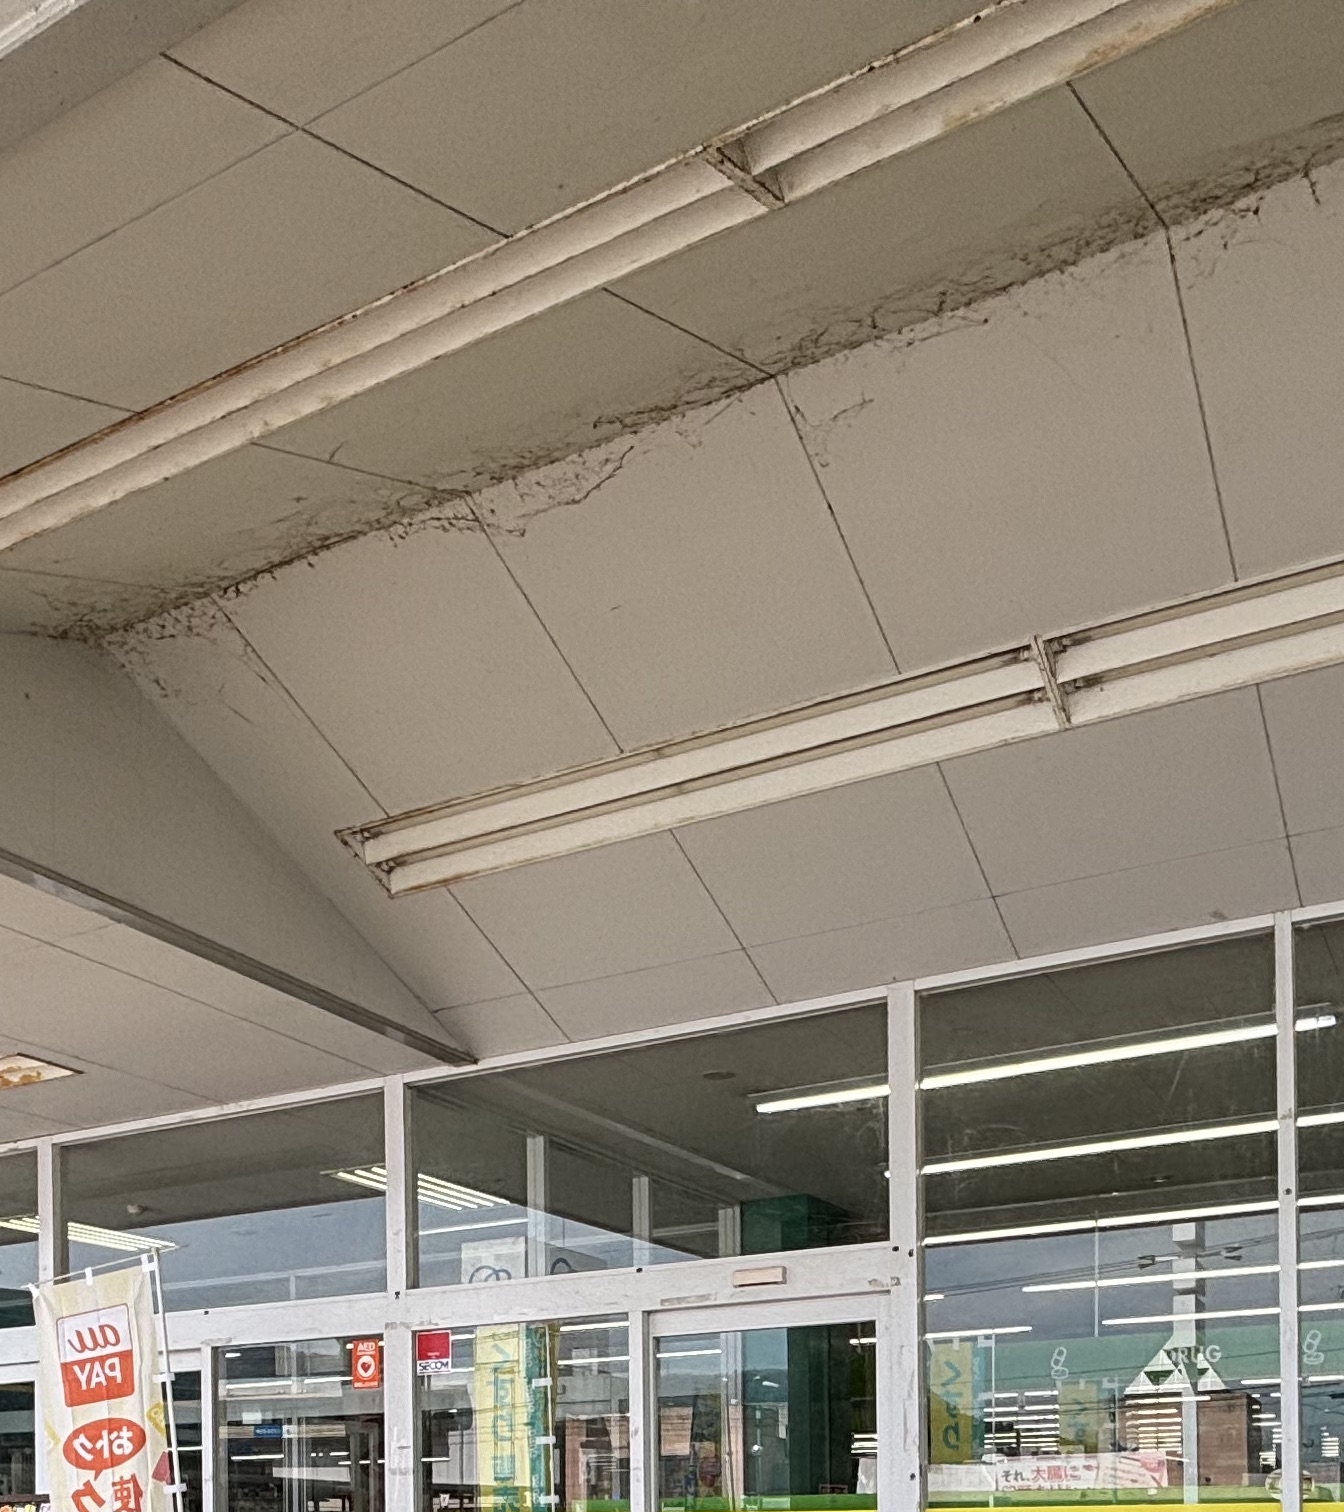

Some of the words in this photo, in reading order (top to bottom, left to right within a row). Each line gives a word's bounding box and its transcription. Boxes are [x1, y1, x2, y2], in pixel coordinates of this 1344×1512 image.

[357, 1342, 376, 1351] AED
[1169, 1344, 1222, 1364] DRUG
[419, 1360, 449, 1372] SECOM
